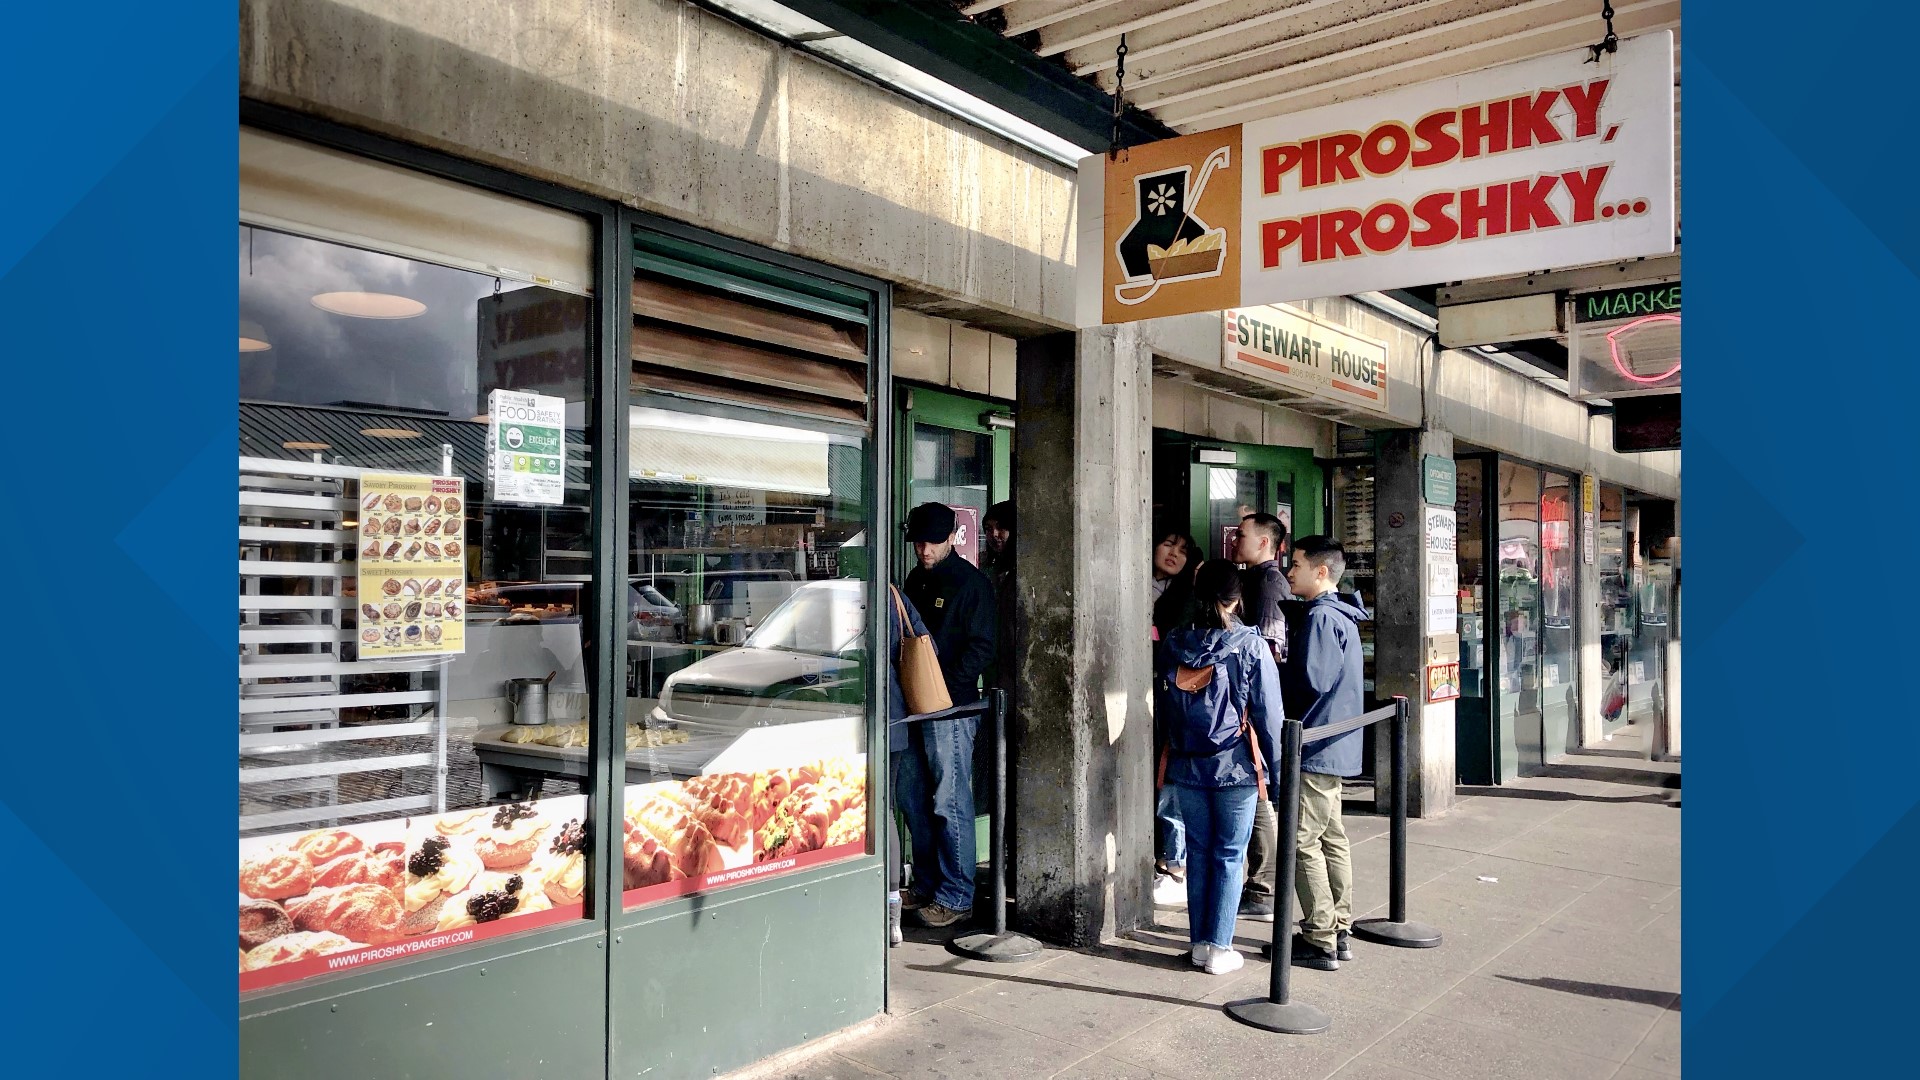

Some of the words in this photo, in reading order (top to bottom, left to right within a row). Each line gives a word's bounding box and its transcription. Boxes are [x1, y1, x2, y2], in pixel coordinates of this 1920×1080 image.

[1261, 78, 1622, 196] PIROSHKY,
[1261, 164, 1649, 270] PIROSHKY...
[1237, 314, 1322, 368] STEWART
[1331, 346, 1378, 387] HOUSE
[499, 405, 537, 421] FOOD
[536, 410, 561, 419] SAFETY
[536, 416, 561, 425] RATING
[528, 435, 558, 446] EXCELLENT
[388, 481, 417, 490] PIROSHKY
[1428, 514, 1455, 534] STEWART
[1430, 536, 1452, 551] HOUSE
[362, 568, 384, 576] SWEET
[1430, 665, 1459, 691] CIGARS
[706, 858, 796, 886] WWW.PIROSHKYBAKERY.COM
[328, 930, 474, 969] WWW.PIROSHKYBAKERY.COM
